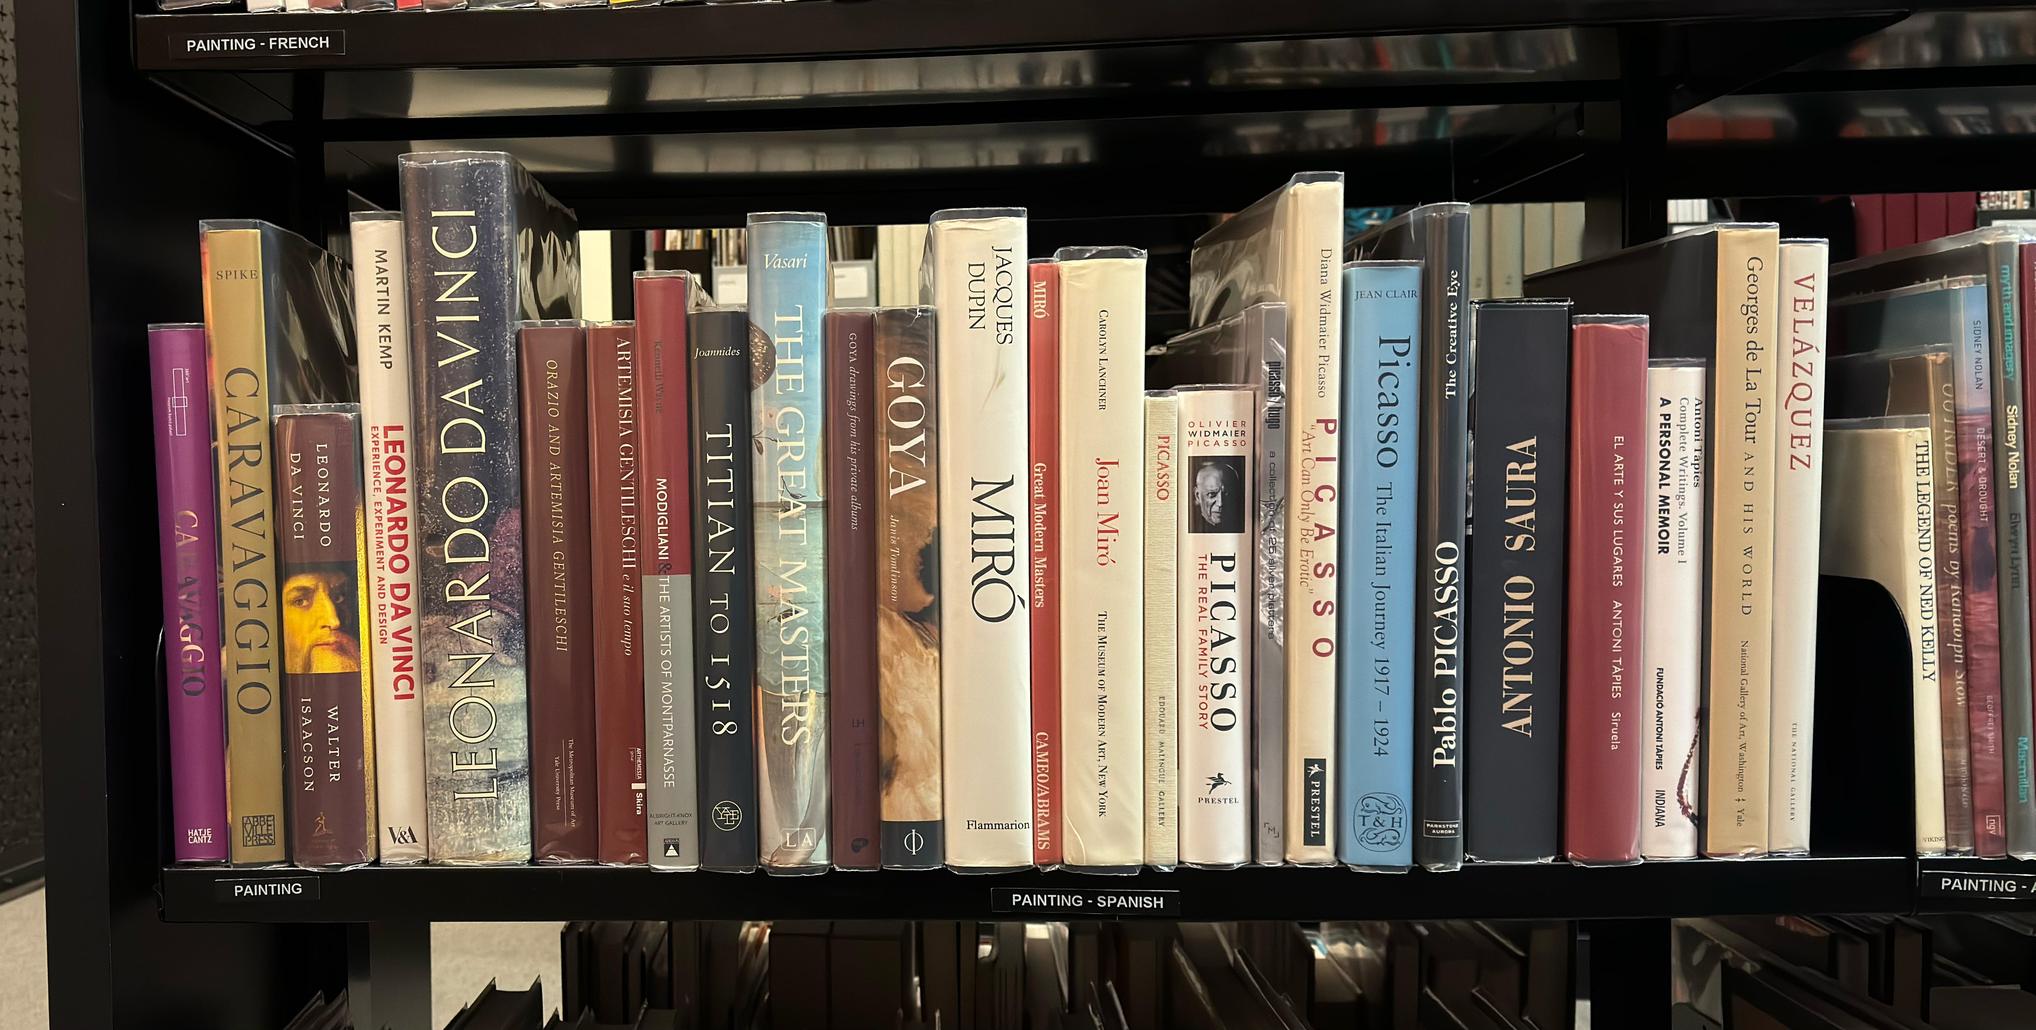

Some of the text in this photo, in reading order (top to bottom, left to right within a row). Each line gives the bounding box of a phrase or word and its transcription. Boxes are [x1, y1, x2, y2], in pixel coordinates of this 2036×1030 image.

[186, 35, 330, 53] PAINTING FRENCH
[216, 269, 258, 281] SPIKE
[374, 249, 394, 370] MARTIN KEMP
[763, 253, 808, 271] Vasari
[968, 262, 986, 330] DUPIN
[992, 246, 1014, 345] JACQUES
[1355, 290, 1418, 300] JEAN CLAIR
[694, 347, 741, 359] Joannides
[1318, 248, 1332, 399] Diana Widmaier Picasso
[1784, 272, 1820, 470] VELÁZQUEZ
[1972, 320, 1984, 391] SIDNEY NOLAN
[2000, 264, 2014, 382] myth and imagery
[616, 337, 636, 569] ARTEMISIA GENTILESCHI
[847, 332, 861, 530] GOYA drawings from his private albums
[887, 356, 927, 499] GOYA
[1156, 435, 1170, 501] PICASSO
[1188, 420, 1246, 428] OLIVIER
[1188, 430, 1246, 438] WIDMAIER
[1188, 440, 1246, 448] PICASSO
[1658, 397, 1672, 554] A PERSONAL MEMOIR
[1690, 398, 1704, 488] Antoni Tàpies
[1740, 256, 1764, 616] Georges de La Tour AND HIS WORLD
[1976, 428, 1988, 522] DESERT & DROUGHT
[2004, 405, 2020, 490] Sidney Nolan
[290, 452, 306, 541] DA VINCI
[316, 443, 332, 548] LEONARDO
[431, 209, 500, 802] LEONARDO DA VINCI
[546, 359, 568, 652] ORAZIO AND ARTEMISIA GENTILESCHI
[774, 304, 812, 747] THE GREAT MASTERS
[1095, 458, 1120, 567] Joan Miró
[1298, 457, 1316, 544] Can Only Be
[1432, 270, 1460, 768] Pablo PICASSO The Creative Eye
[1675, 397, 1690, 557] Complete Writings. Volume
[223, 367, 272, 716] CARAVAGGIO
[370, 425, 388, 646] EXPERIENCE, EXPERIMENT AND DESIGN
[383, 424, 415, 701] LEONARDO DA VINCI
[705, 423, 738, 735] TITIAN TO 1518
[890, 514, 901, 602] Janis Tomlinson
[971, 474, 1026, 623] MIRÓ
[1033, 280, 1050, 850] MIRÓ Great Modern Masters CAMEO/ABRAMS
[1312, 418, 1337, 658] PICASSO
[1370, 335, 1411, 757] Picasso The Italian Journey 1917 1924
[1501, 436, 1538, 739] ANTONIO SAURA
[1915, 440, 1936, 682] THE LEGEND OF NED KELLY
[656, 478, 675, 789] MODIGLIANI THE ARTISTS OF MONTPARNASSE
[1198, 554, 1208, 730] THE REAL FAMILY STORY
[1210, 552, 1237, 732] PICASSO
[1610, 436, 1625, 751] EL ARTE Y SUS LUGARES ANTONI TÀPIES Siruela
[300, 697, 315, 793] ISAACSON
[327, 705, 341, 783] WALTER
[1655, 668, 1666, 828] FUNDACIÓ ANTONI TÀPIES INDIANA
[1736, 640, 1749, 827] National Gallery of Washington Yale
[2018, 736, 2030, 804] Macmillan
[187, 828, 213, 837] HATJE
[187, 836, 213, 844] CANTZ
[388, 826, 418, 845] V&A
[966, 820, 1030, 830] Flammarion
[1198, 797, 1240, 805] PRESTEL
[1310, 780, 1321, 838] PRESTEL
[1987, 818, 1998, 835] ngv
[234, 883, 303, 897] PAINTING
[1012, 894, 1164, 909] PAINTING SPANISH
[1940, 877, 2017, 893] PAINTING
